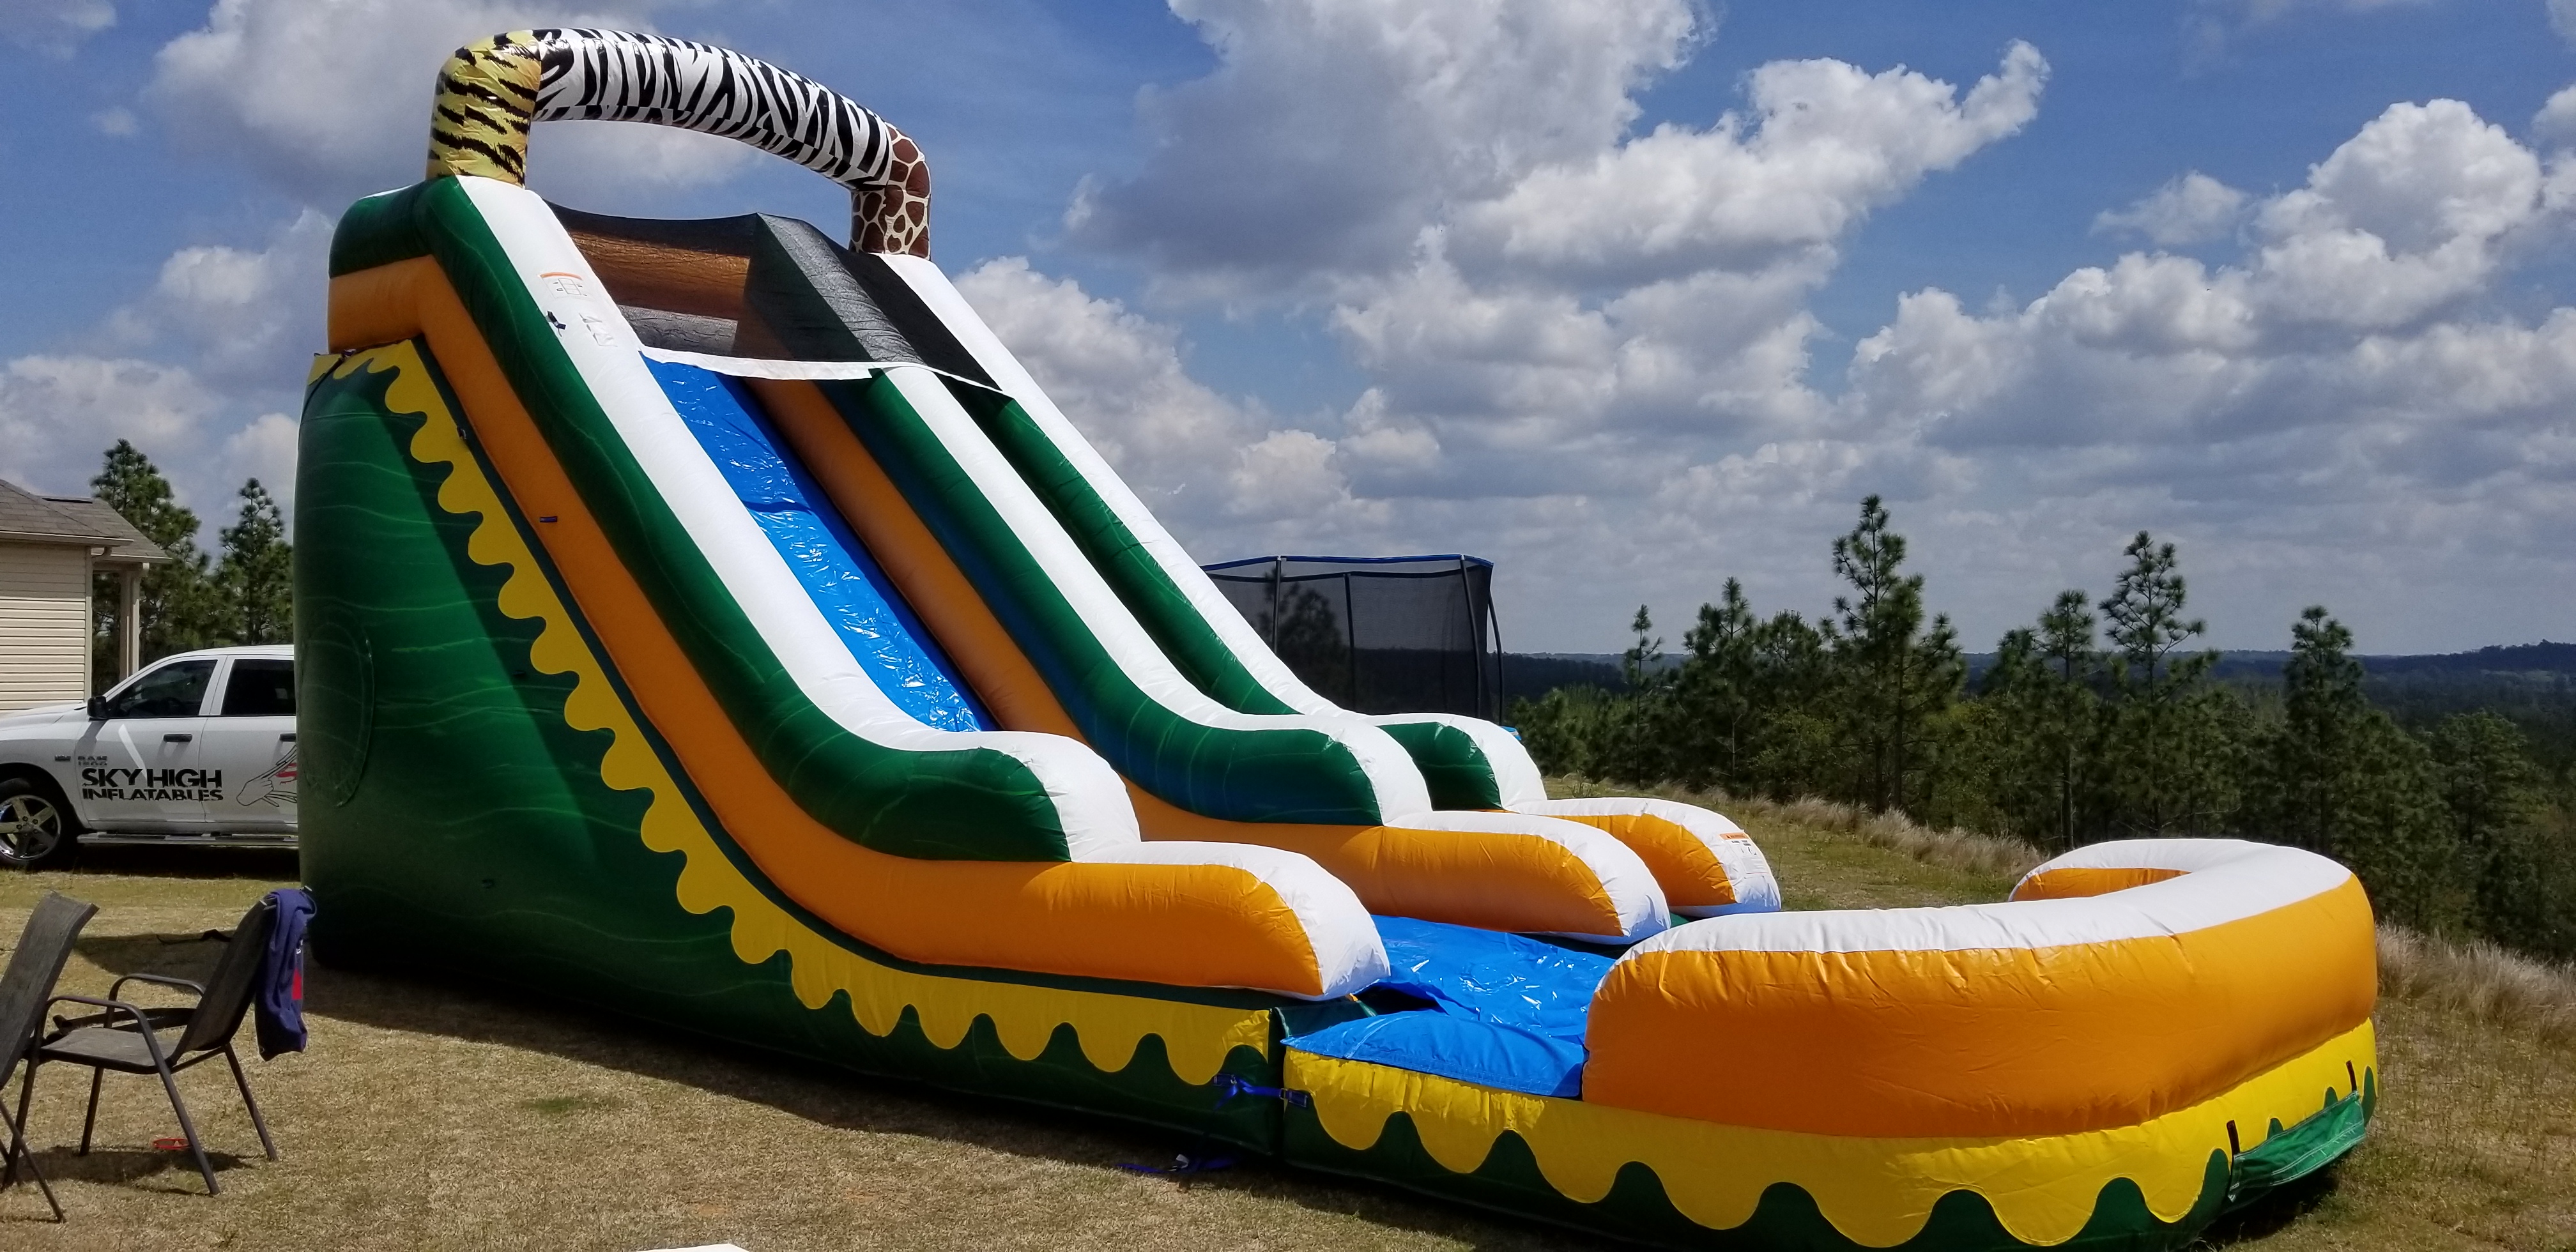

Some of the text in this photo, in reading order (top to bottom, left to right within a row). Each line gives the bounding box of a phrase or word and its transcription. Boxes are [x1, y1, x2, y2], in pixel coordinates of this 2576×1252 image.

[82, 768, 222, 788] SKY HIGH
[82, 788, 224, 801] INFLATABLES
